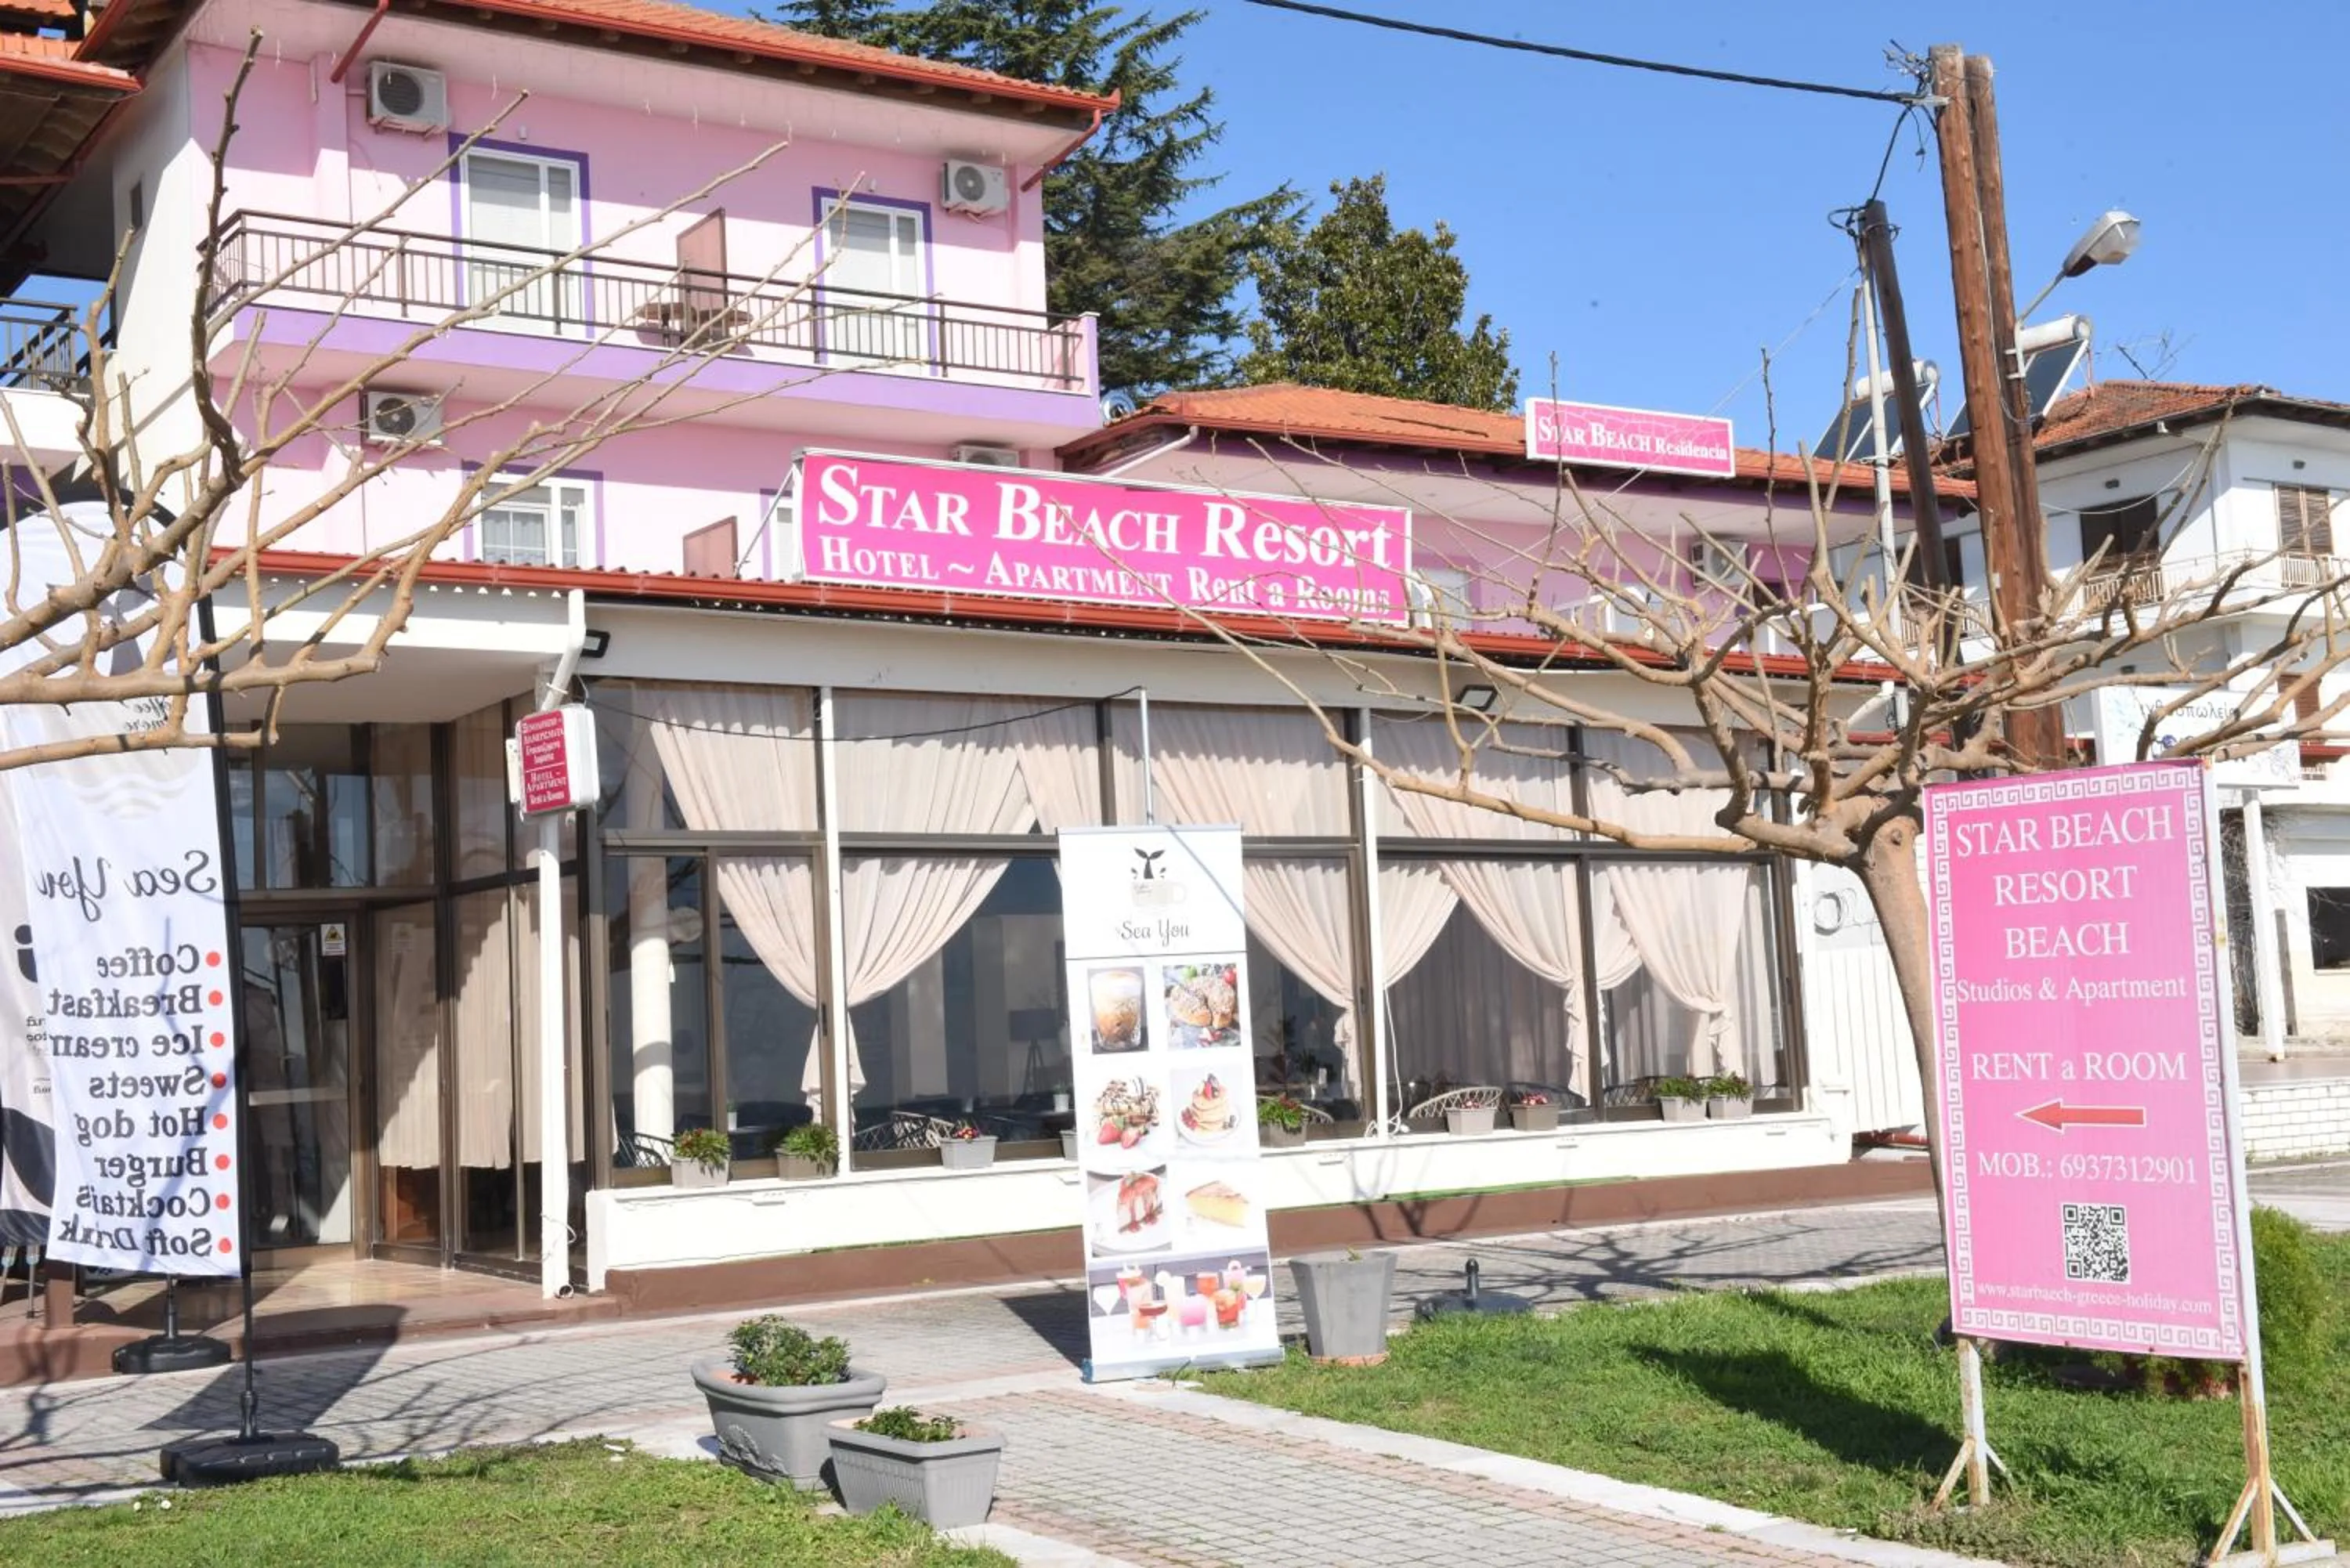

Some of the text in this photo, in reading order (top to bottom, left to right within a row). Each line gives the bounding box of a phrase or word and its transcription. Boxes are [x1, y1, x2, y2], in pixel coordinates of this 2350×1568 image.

[1589, 422, 1651, 453] BEACH
[818, 464, 1392, 569] STAR BEACH Resort
[819, 535, 939, 580] HOTEL
[984, 551, 1173, 598] APARTMENT
[1186, 566, 1257, 605] Rent
[1268, 581, 1286, 608] a
[1296, 576, 1391, 616] Rooms
[1955, 804, 2175, 858] STAR BEACH
[1992, 865, 2138, 908] RESORT
[1120, 918, 1191, 947] Sea You
[2004, 921, 2132, 960] BEACH
[1956, 975, 2188, 1006] Studios & Apartment
[1971, 1051, 2189, 1082] RENT a ROOM
[1976, 1151, 2198, 1185] MOB.: 6937312901
